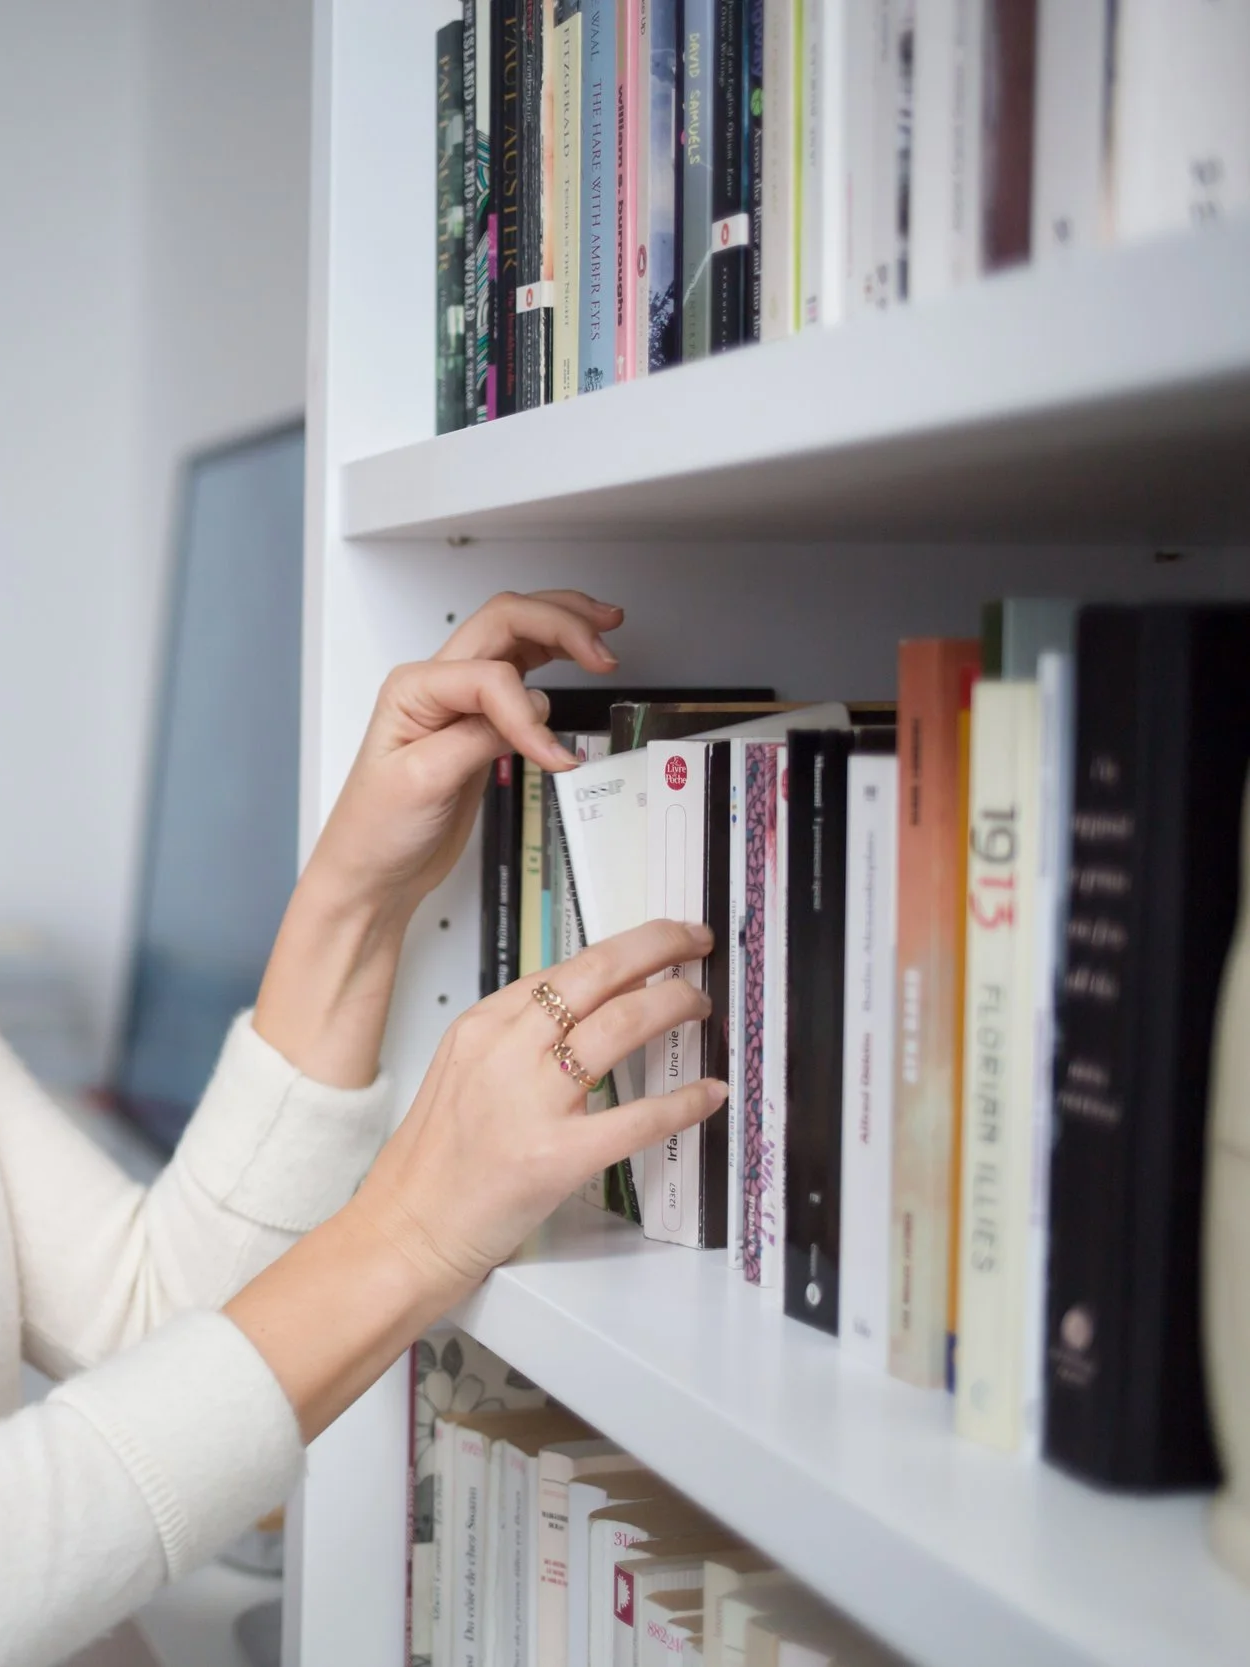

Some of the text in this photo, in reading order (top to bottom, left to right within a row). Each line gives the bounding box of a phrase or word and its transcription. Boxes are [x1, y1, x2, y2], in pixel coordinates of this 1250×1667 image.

[463, 27, 475, 100] ISLAND
[590, 10, 600, 62] WAAL
[526, 53, 534, 122] Frankenstein
[562, 27, 571, 158] FITZGERALD
[687, 33, 702, 166] DAVID SAMUELS
[502, 16, 519, 274] PAUL AUSTER
[617, 83, 625, 168] william
[464, 158, 476, 198] END
[590, 78, 602, 341] THE HARE WITH AMBER EYES
[616, 199, 624, 327] burroughs
[753, 127, 762, 338] Across the River and into the
[463, 251, 476, 321] WORLD
[665, 774, 687, 786] Poche
[667, 763, 687, 774] Livre
[968, 804, 1018, 932] 1913
[668, 1030, 679, 1049] vie
[668, 1053, 679, 1078] Une
[969, 982, 1004, 1275] FLORIAN ILLIES
[464, 1486, 478, 1531] Swann
[463, 1568, 475, 1587] de
[464, 1536, 476, 1566] chez
[463, 1588, 475, 1619] côté
[463, 1622, 475, 1643] Du
